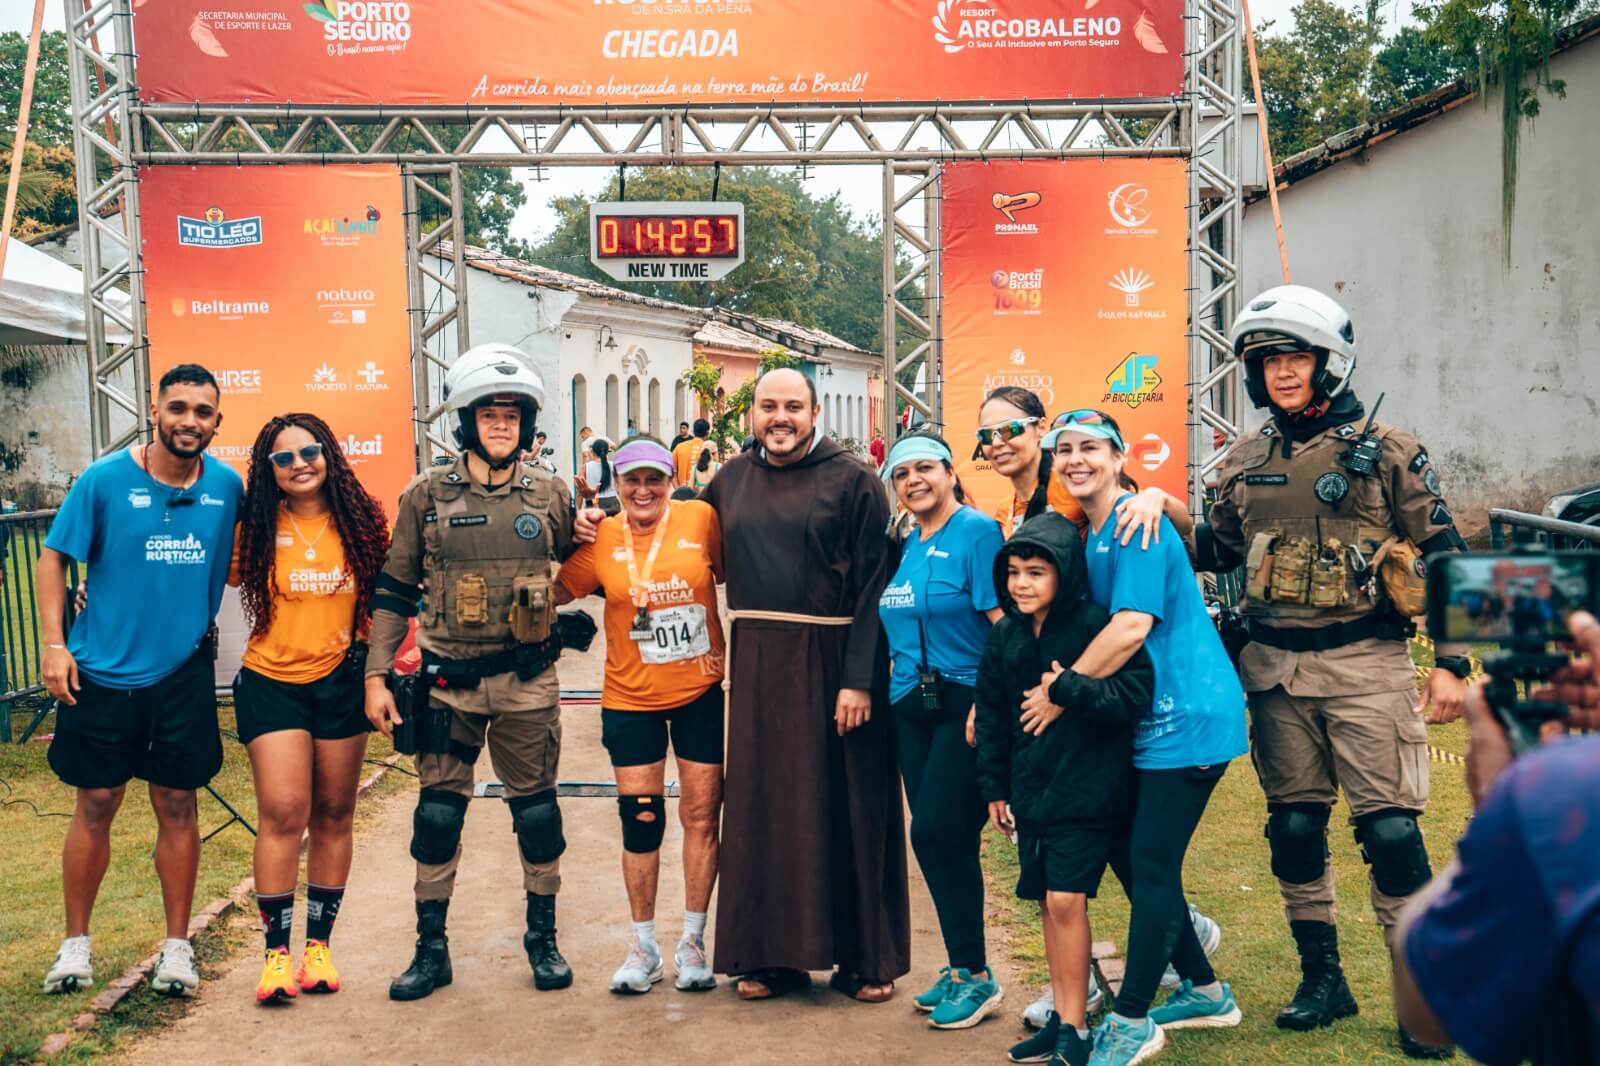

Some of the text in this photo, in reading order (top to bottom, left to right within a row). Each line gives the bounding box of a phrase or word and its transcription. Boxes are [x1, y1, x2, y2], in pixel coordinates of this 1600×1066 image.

[199, 11, 288, 21] SECRETARIA MUNICIPAL
[337, 1, 411, 21] PORTO
[632, 5, 651, 15] DE
[695, 4, 714, 14] DA
[717, 4, 752, 14] PENA
[960, 9, 997, 17] RESORT
[215, 21, 292, 31] DE ESPORTE E LAZER
[324, 21, 412, 41] SEGURO
[958, 17, 1121, 38] ARCOBALENO
[602, 28, 740, 59] CHEGADA
[994, 40, 1006, 48] All
[1007, 40, 1047, 48] Inclusive
[1063, 39, 1087, 47] Porto
[1088, 39, 1120, 48] Seguro
[471, 71, 869, 100] A corrida mais abençoada na terra mãe do Brasil!
[182, 222, 257, 239] TIO LÉO
[995, 223, 1039, 232] PRONAEL
[183, 236, 258, 245] SUPERMERCADOS
[628, 263, 709, 278] NEW TIME
[1009, 271, 1042, 281] Porto
[1009, 279, 1041, 289] Brasil
[316, 288, 375, 302] natura
[192, 300, 269, 315] Beltrame
[212, 369, 261, 387] HREE
[1030, 375, 1053, 389] DO
[354, 383, 389, 392] CULTURA
[1101, 392, 1164, 403] JP BICICLETARIA
[145, 537, 202, 550] CORRIDA
[655, 621, 691, 648] 014
